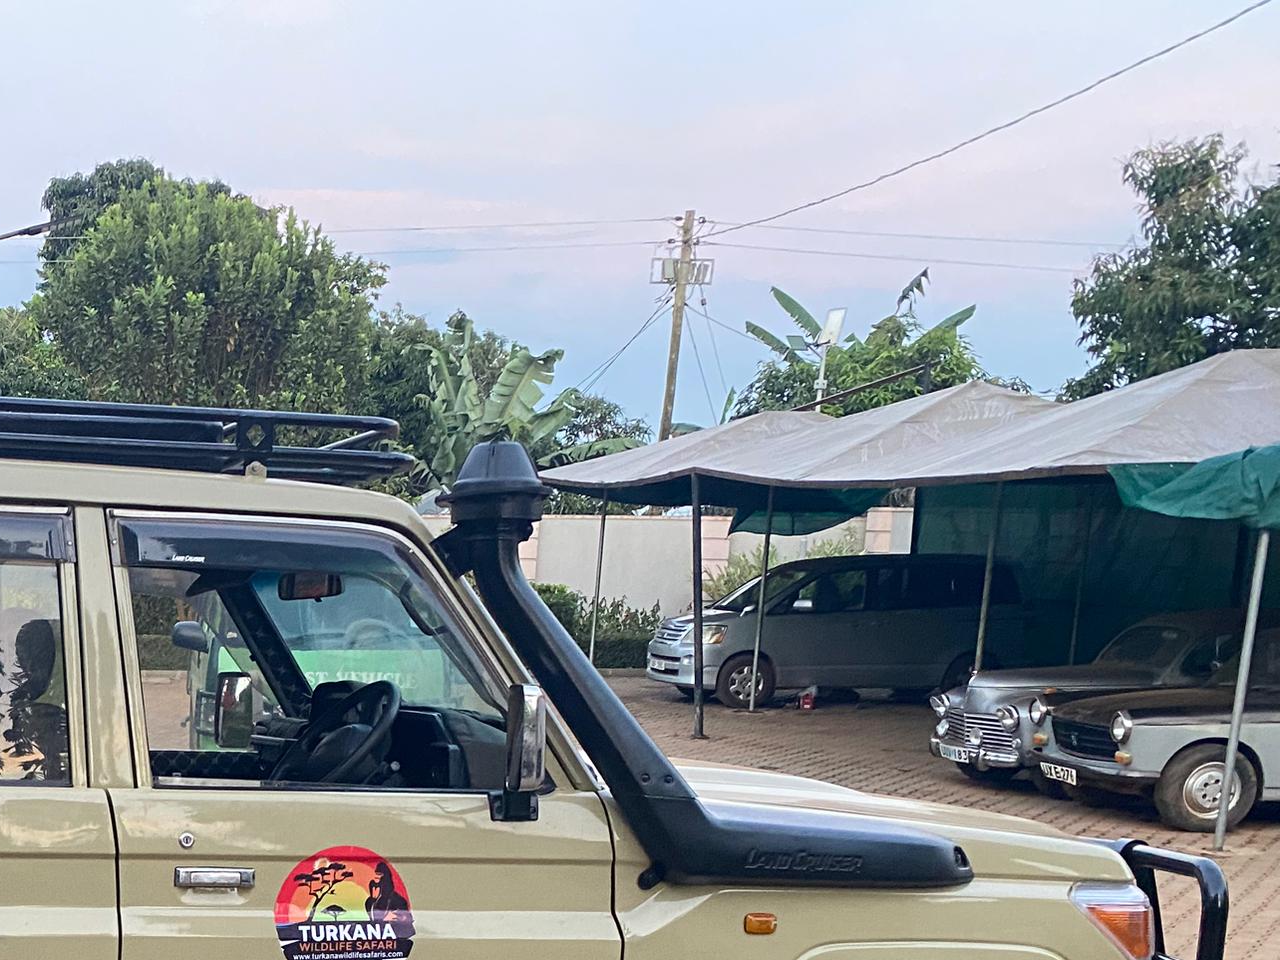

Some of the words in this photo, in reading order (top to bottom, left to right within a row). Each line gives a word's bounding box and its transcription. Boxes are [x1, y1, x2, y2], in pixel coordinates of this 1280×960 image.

[298, 923, 397, 942] TURKANA
[300, 941, 352, 952] WILDLIFE
[356, 940, 397, 950] SAFARI
[293, 951, 404, 960] www.turkanawildlifesafaris.com
